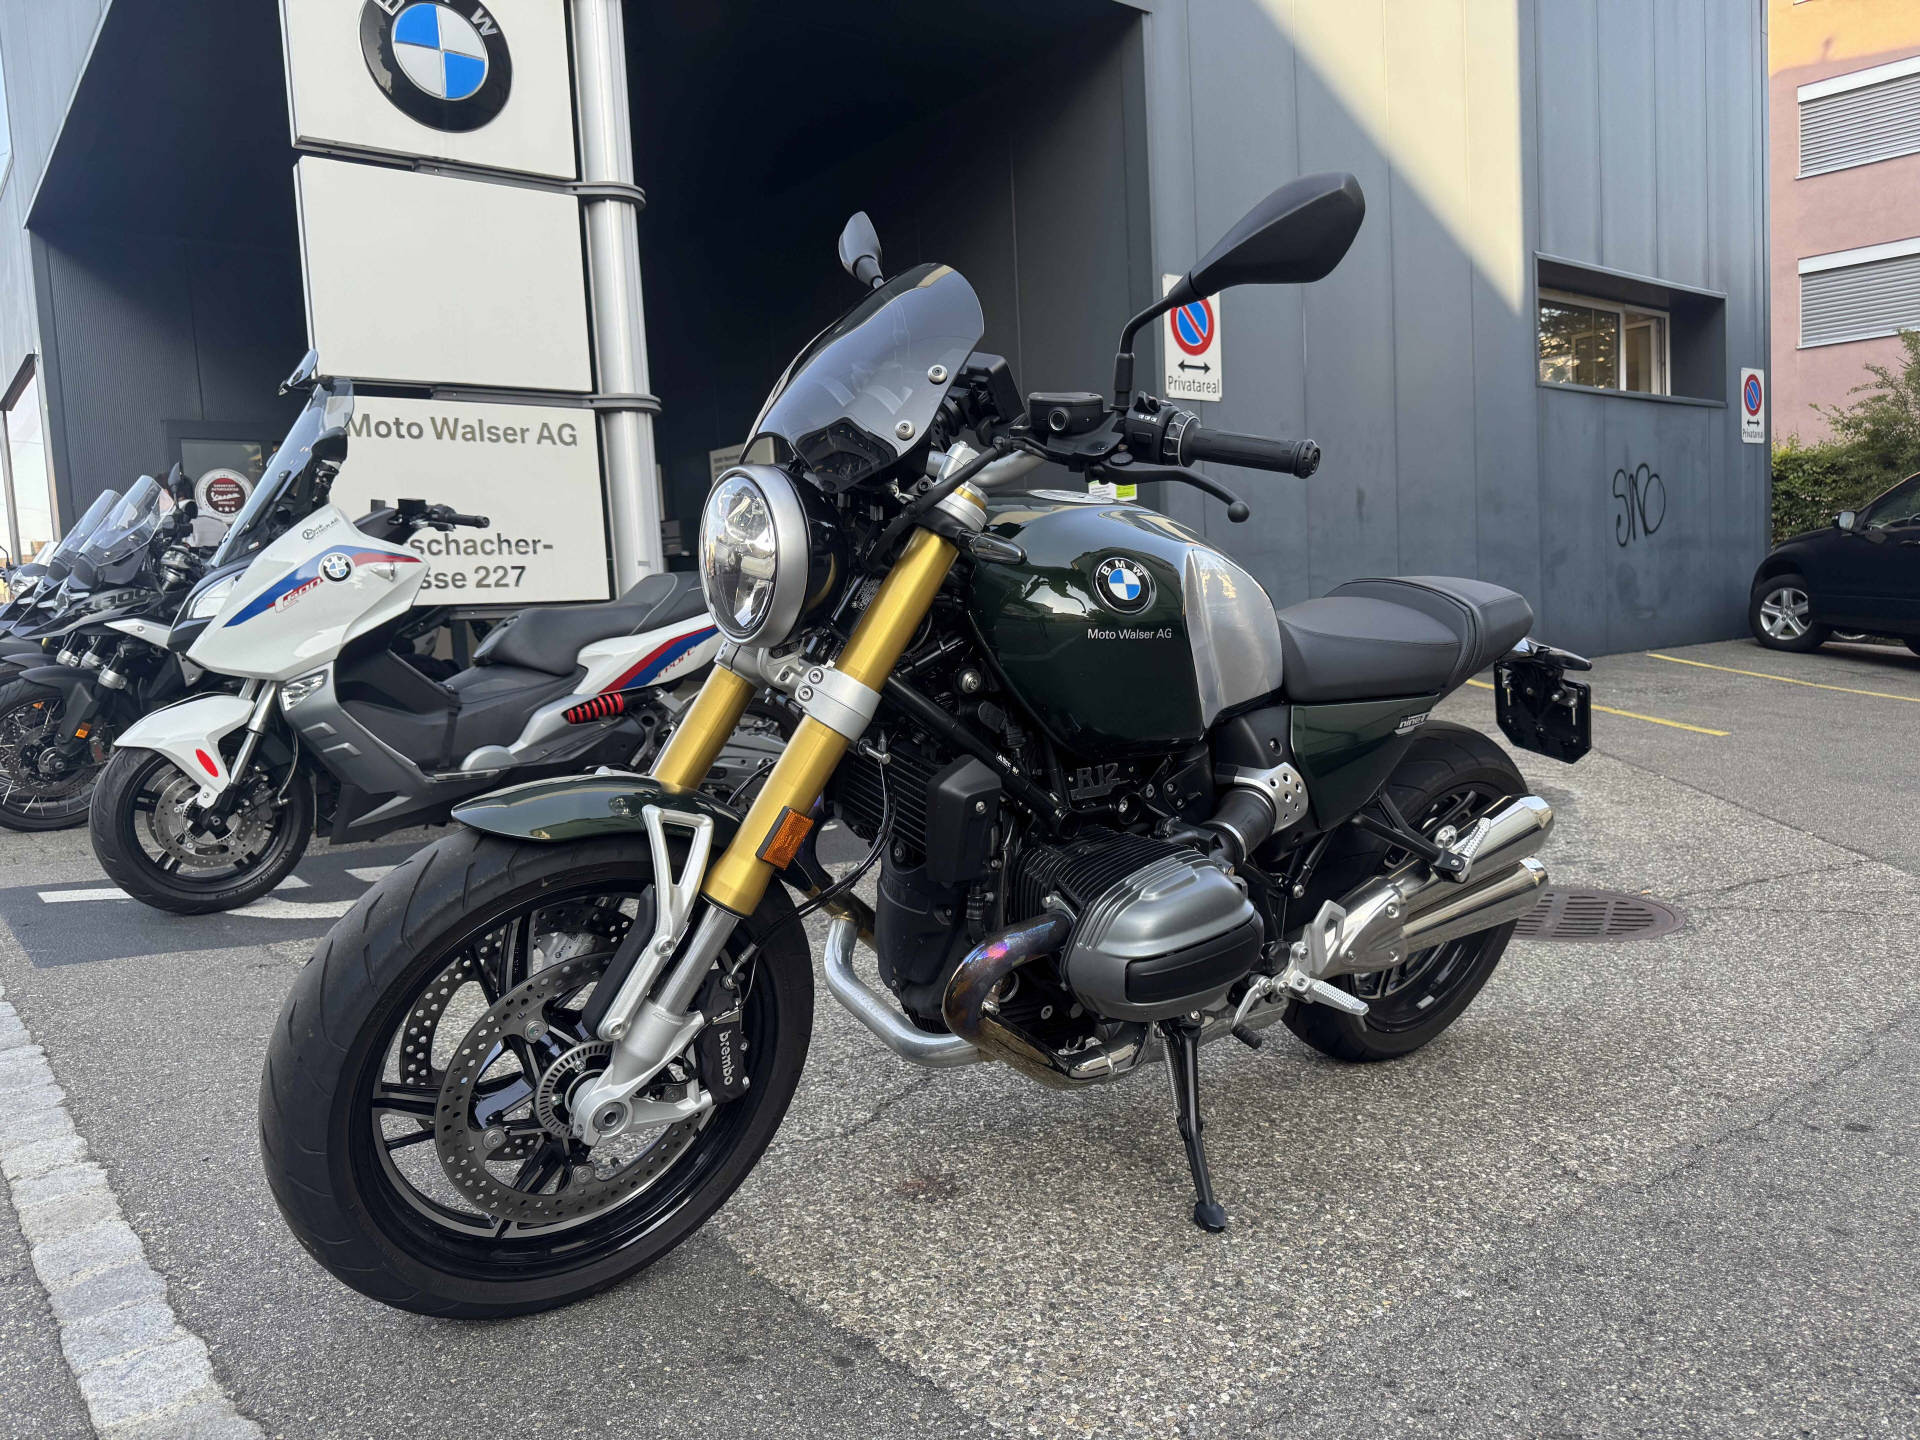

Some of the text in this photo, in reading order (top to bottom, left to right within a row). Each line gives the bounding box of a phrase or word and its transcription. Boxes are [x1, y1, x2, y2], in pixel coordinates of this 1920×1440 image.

[1168, 375, 1220, 394] Privatareal
[345, 413, 578, 446] Moto Walser AG
[473, 565, 526, 588] 227
[1101, 560, 1144, 577] BMW
[1087, 628, 1172, 639] Moto Walser AG
[719, 1030, 735, 1086] brembo
